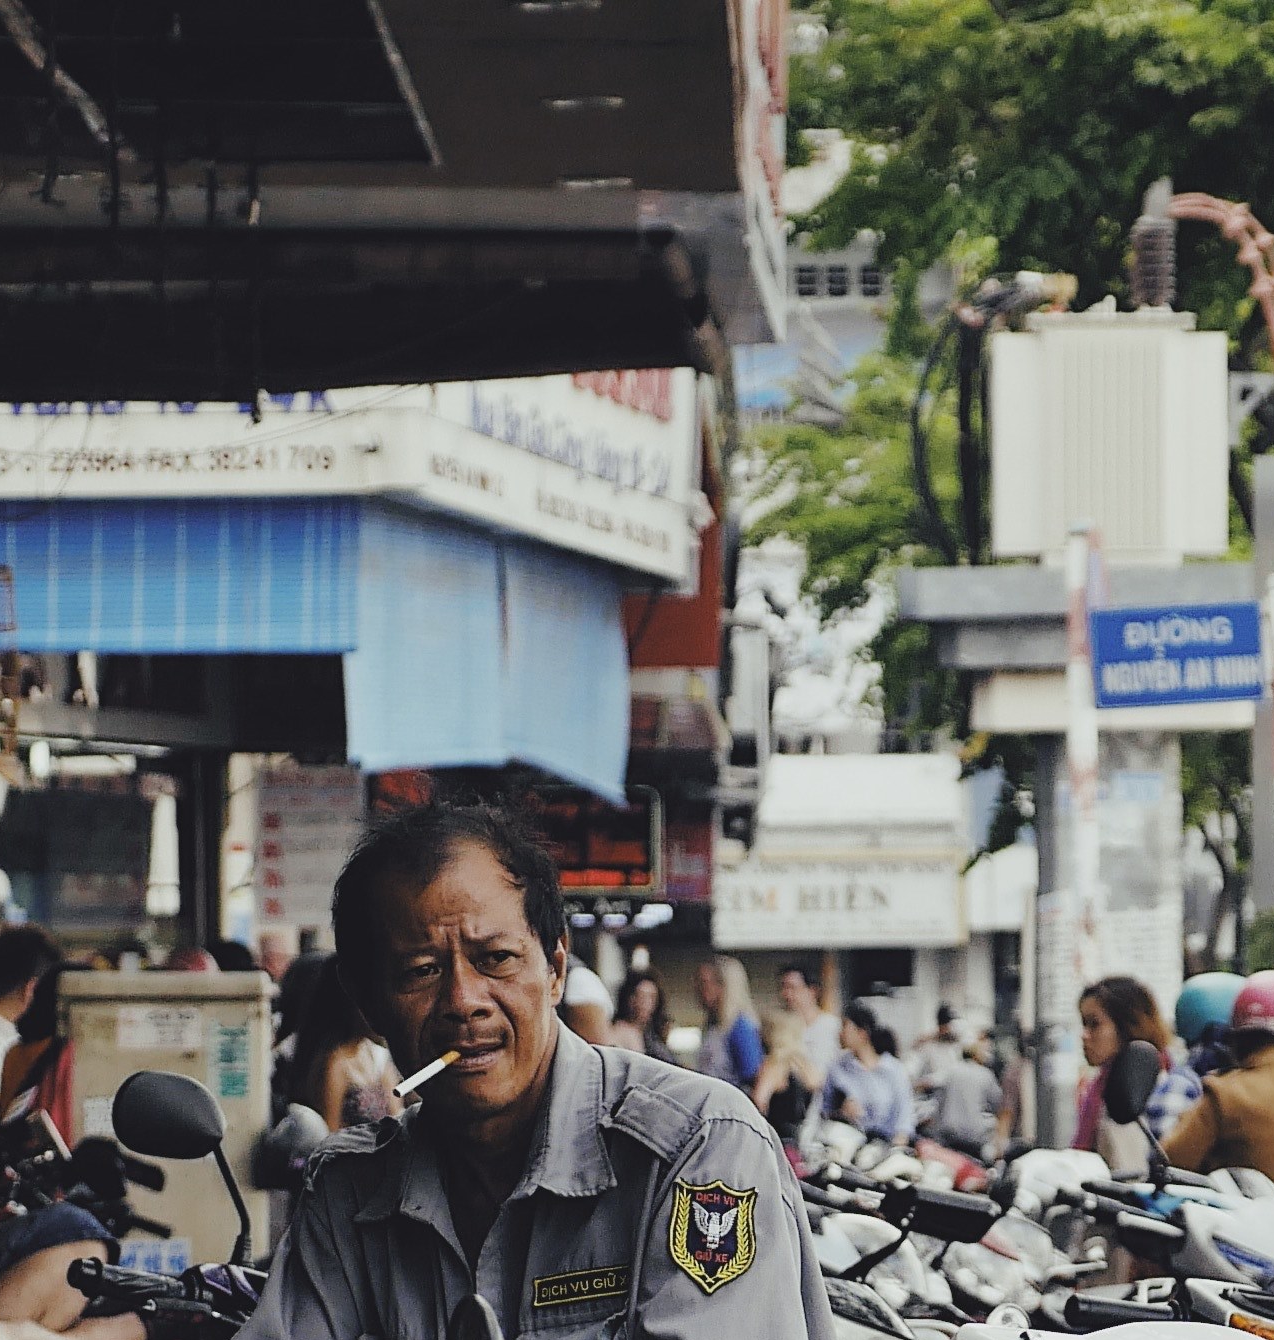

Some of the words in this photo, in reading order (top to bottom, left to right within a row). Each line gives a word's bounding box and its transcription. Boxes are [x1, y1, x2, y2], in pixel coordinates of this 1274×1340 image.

[1184, 656, 1212, 690] AN
[695, 1191, 721, 1205] DỊCH
[694, 1247, 713, 1262] GIỮ
[714, 1251, 730, 1263] XE
[541, 1283, 569, 1301] DỊCH
[569, 1279, 590, 1295] VỤ
[592, 1271, 617, 1290] GIỮ
